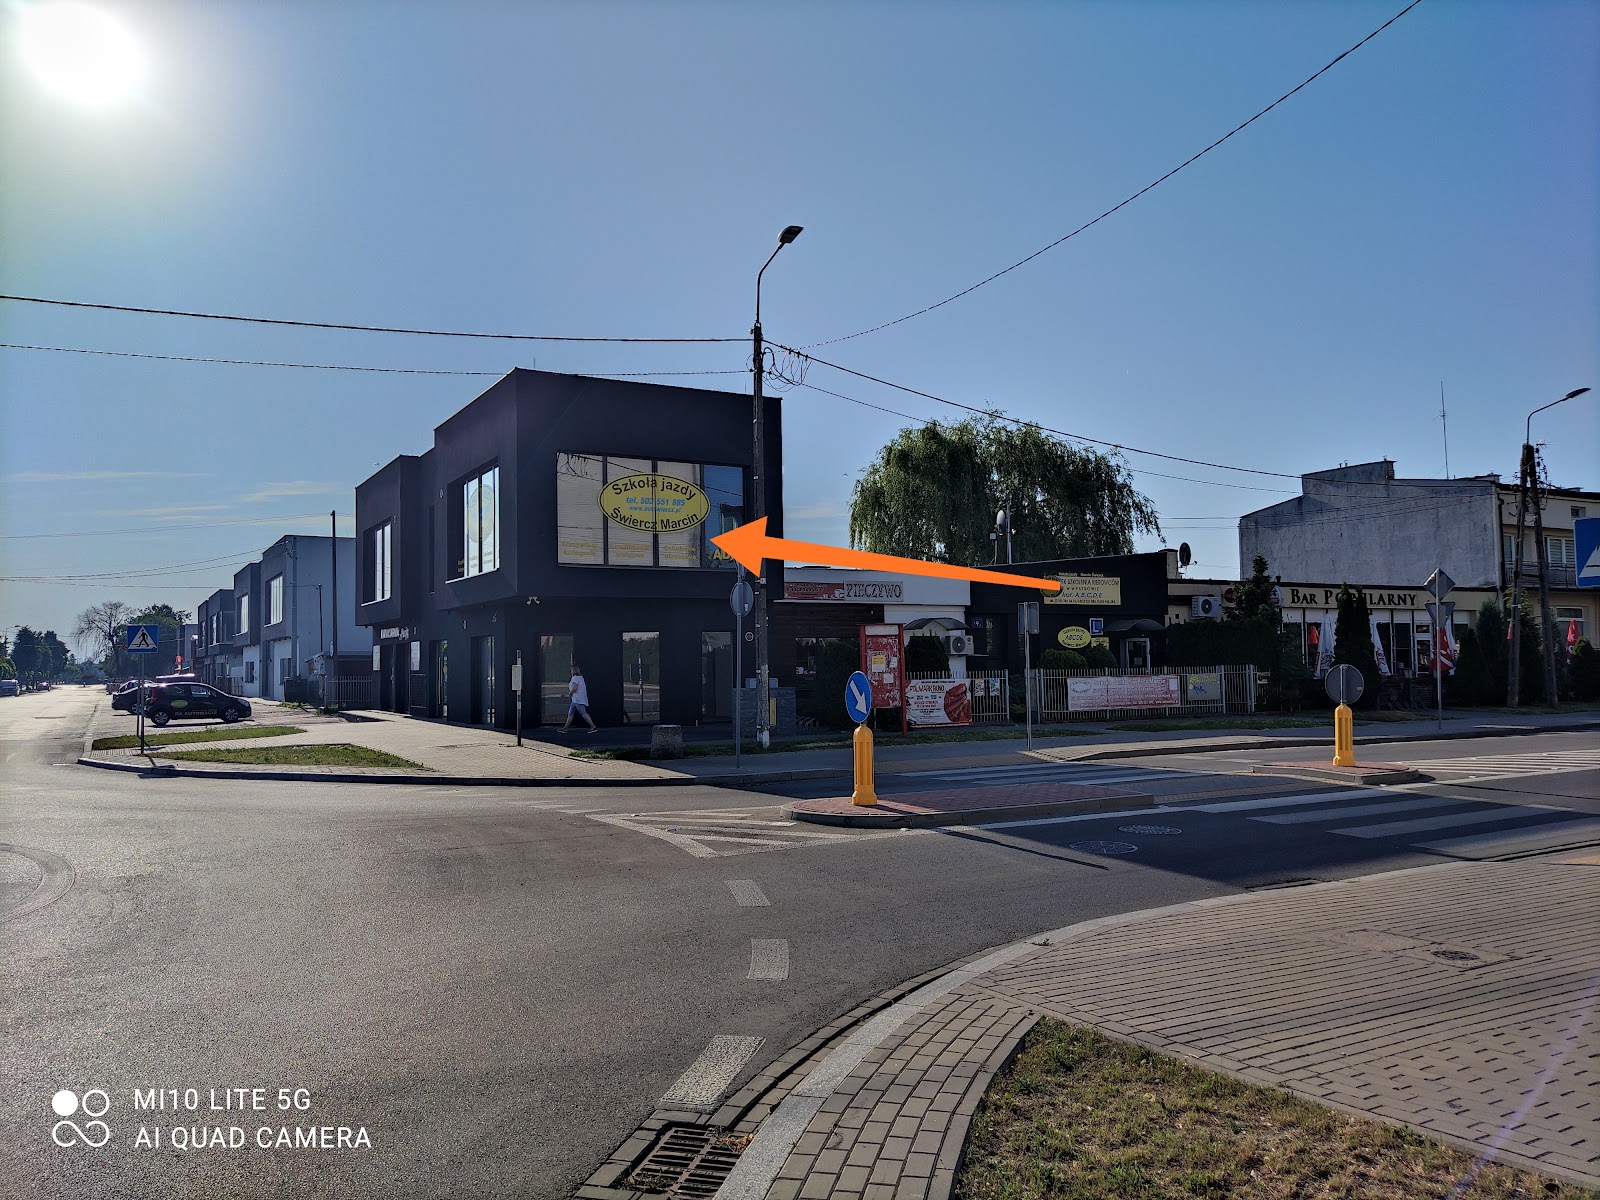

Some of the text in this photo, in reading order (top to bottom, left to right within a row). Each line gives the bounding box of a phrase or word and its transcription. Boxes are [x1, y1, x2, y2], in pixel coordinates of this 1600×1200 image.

[611, 477, 697, 501] Szkoła jazdy
[626, 496, 686, 507] tel. 502 551 885
[610, 506, 699, 530] Świercz Marcin
[713, 548, 733, 561] AD
[845, 583, 902, 599] PIECZYWO
